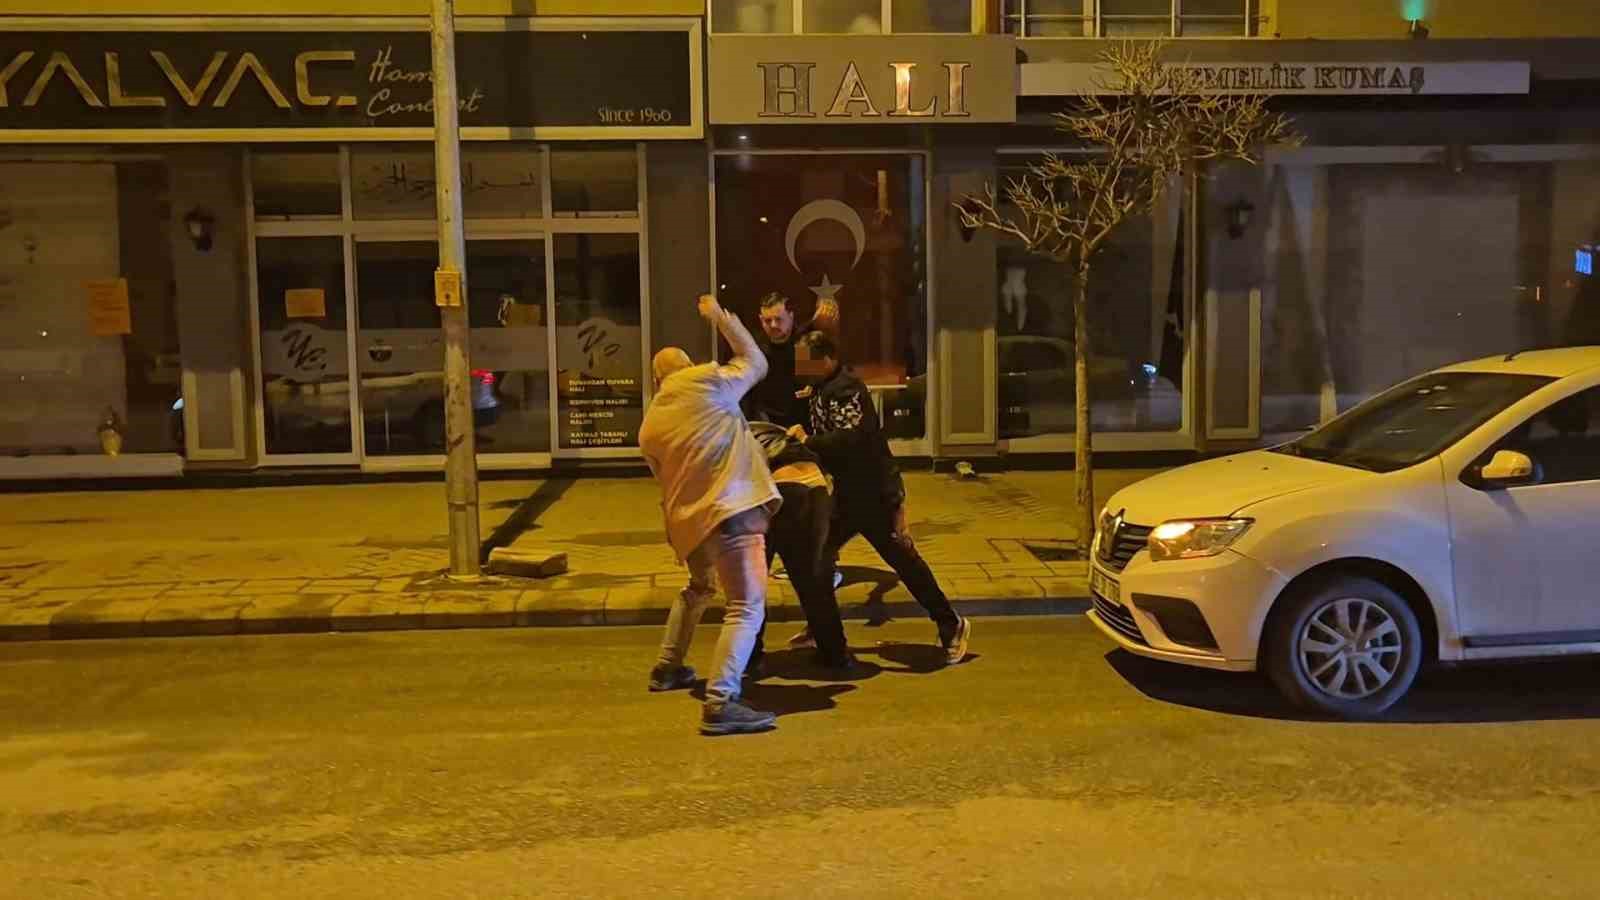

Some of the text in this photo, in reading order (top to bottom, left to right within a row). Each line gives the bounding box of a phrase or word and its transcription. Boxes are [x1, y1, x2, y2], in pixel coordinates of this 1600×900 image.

[368, 45, 435, 83] Hom
[1314, 66, 1424, 94] KUMAŞ
[756, 60, 971, 117] HALI
